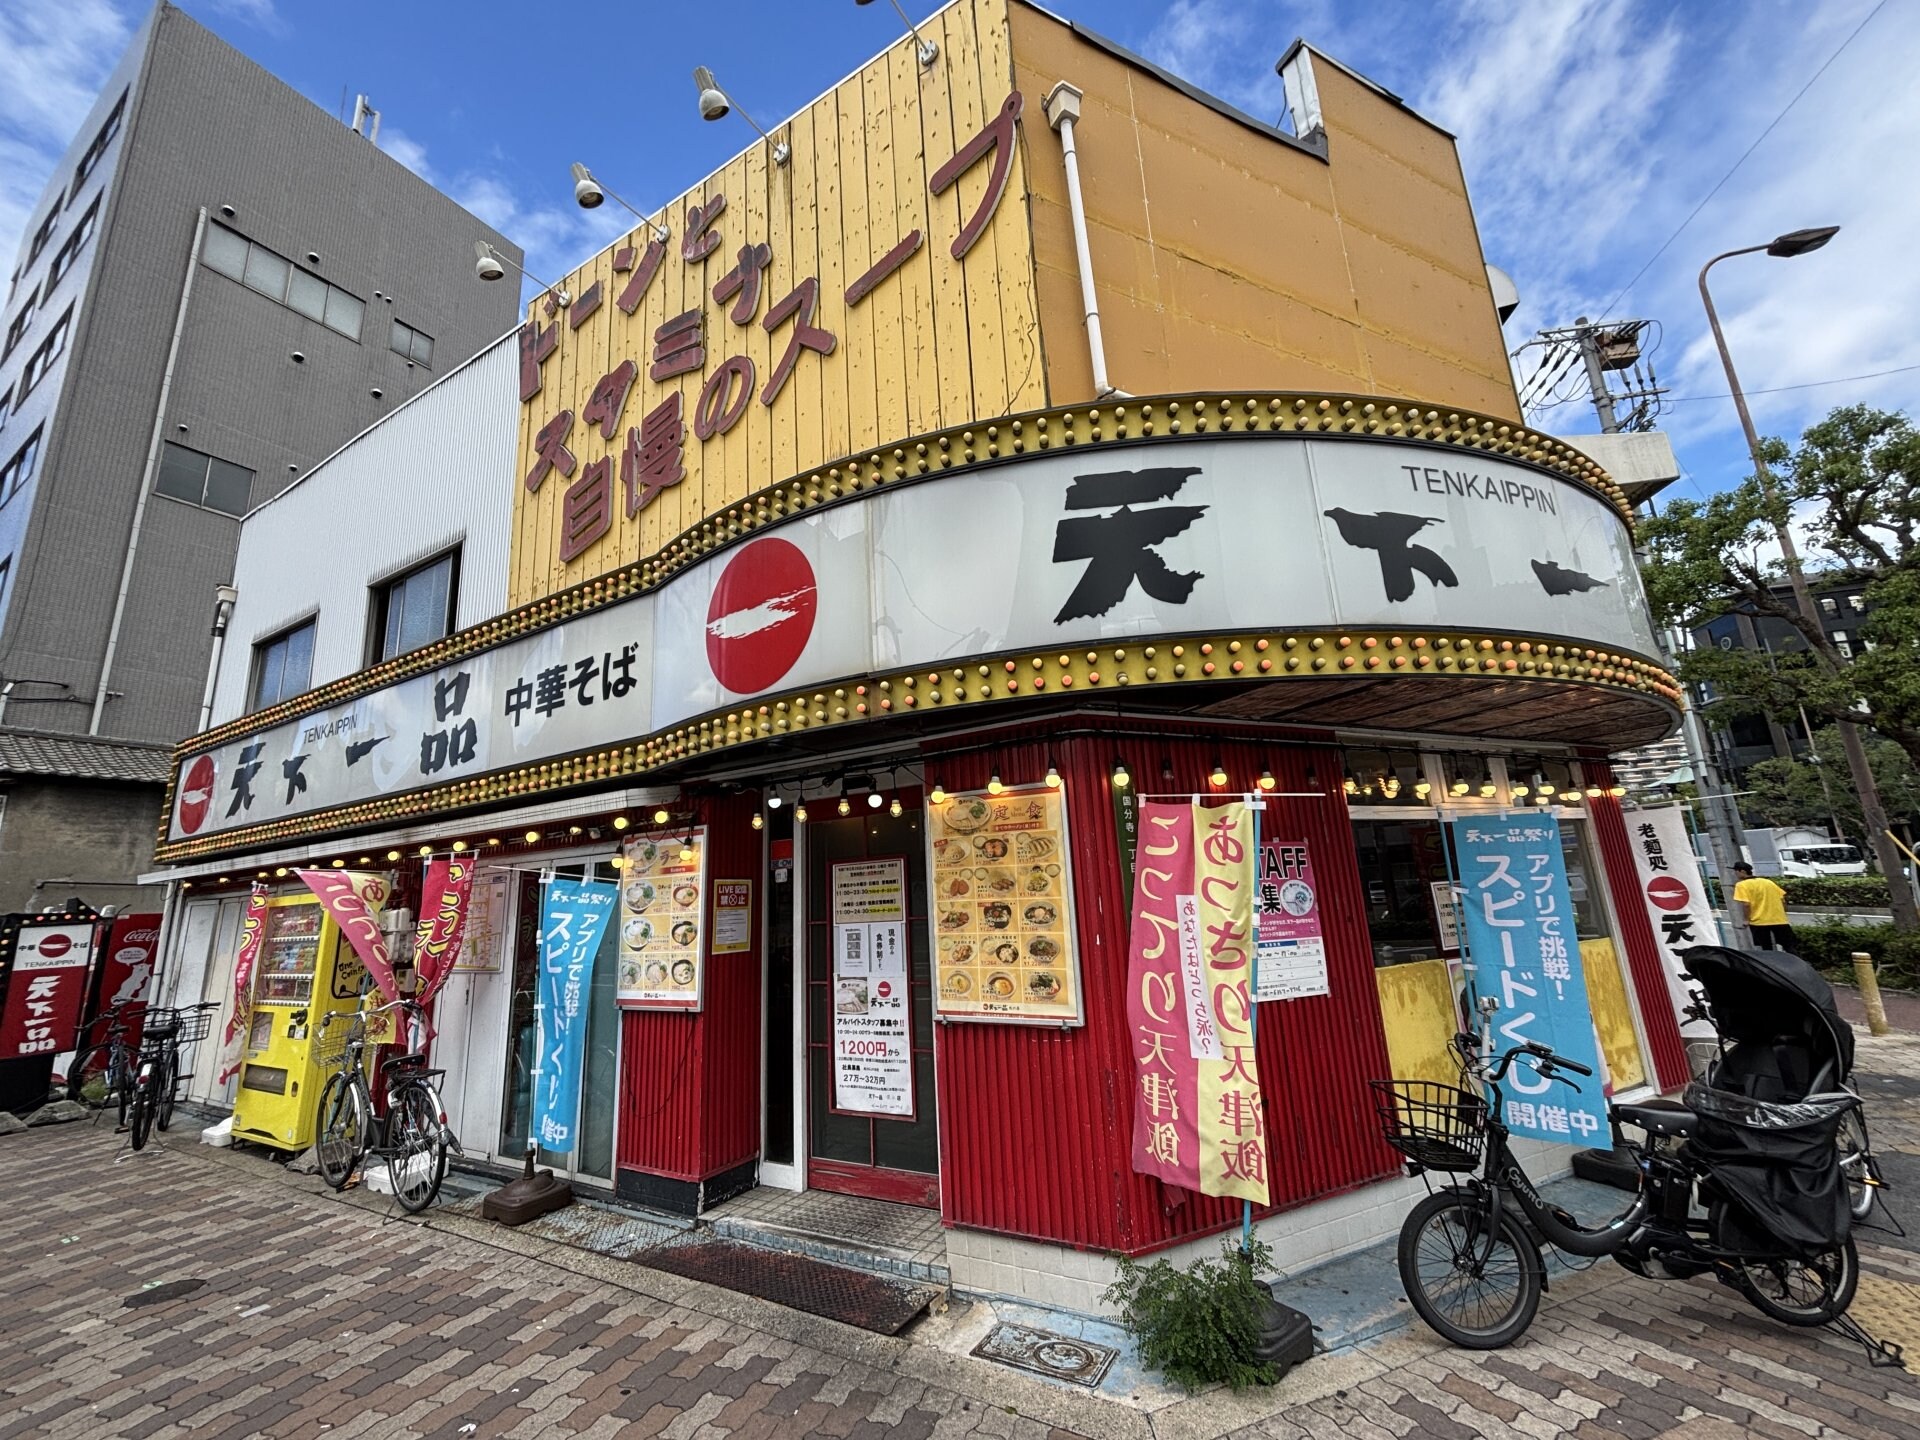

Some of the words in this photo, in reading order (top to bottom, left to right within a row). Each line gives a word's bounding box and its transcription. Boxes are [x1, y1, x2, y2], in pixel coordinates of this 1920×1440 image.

[526, 242, 772, 494] スタミナ
[1401, 464, 1556, 517] TENKAIPPIN
[504, 641, 639, 729] 中華そば
[224, 671, 478, 820] 天下一品
[302, 713, 359, 746] TENKAIPPIN
[1466, 828, 1554, 844] 天下一品祭り
[550, 890, 613, 905] 天下一品祭り
[718, 885, 734, 894] LIVE
[1526, 854, 1571, 1001] アプリで挑戦!
[23, 959, 76, 968] TENKAIPPIN
[18, 975, 63, 1054] 天下一品
[839, 1040, 887, 1057] 1200円
[888, 1048, 900, 1057] から
[1506, 1100, 1598, 1138] 開催中
